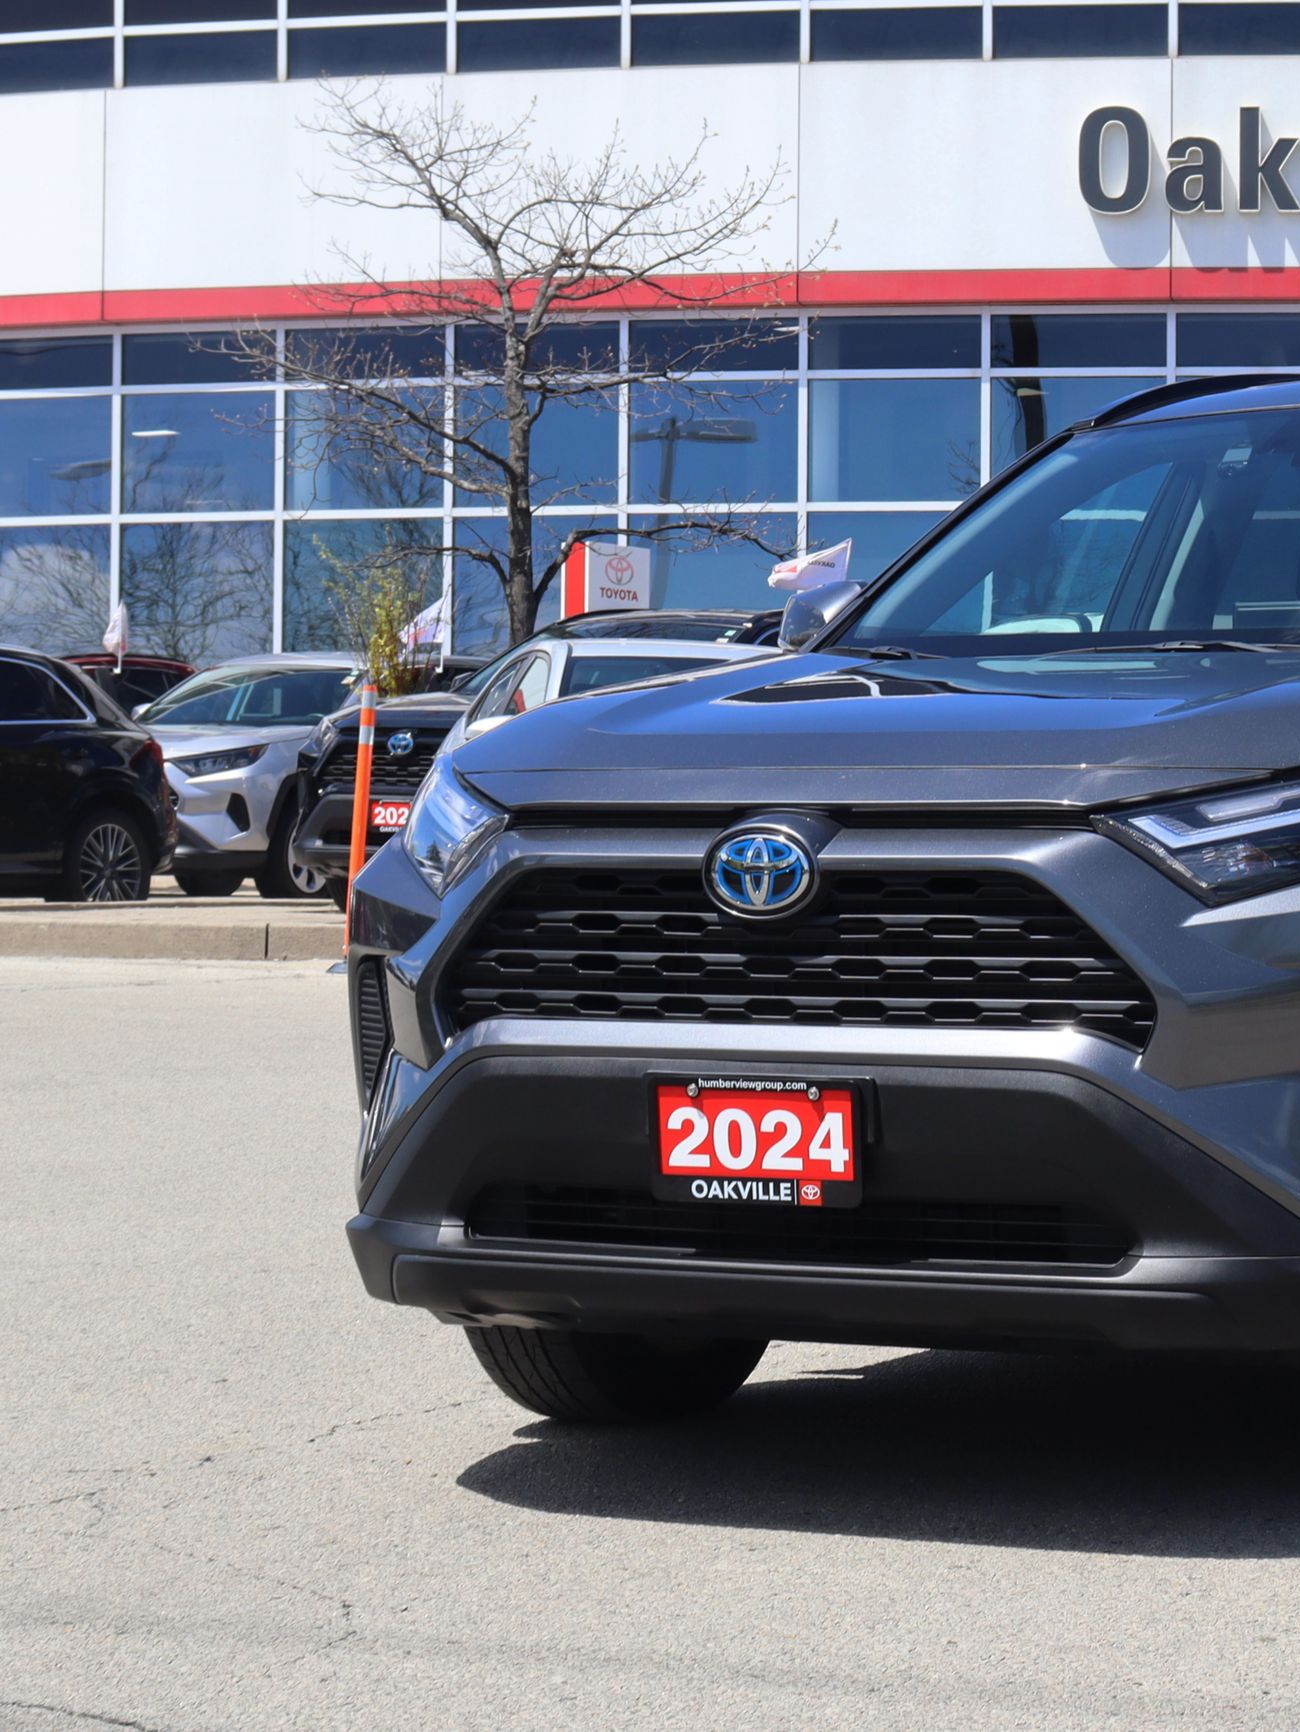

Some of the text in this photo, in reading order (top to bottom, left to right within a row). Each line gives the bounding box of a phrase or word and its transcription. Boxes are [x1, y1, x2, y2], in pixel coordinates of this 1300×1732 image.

[599, 587, 639, 602] TOYOTA
[373, 806, 409, 825] 202
[698, 1078, 807, 1092] humberviewgroup.com
[667, 1106, 849, 1173] 2024
[691, 1179, 792, 1201] OAKVILLE
